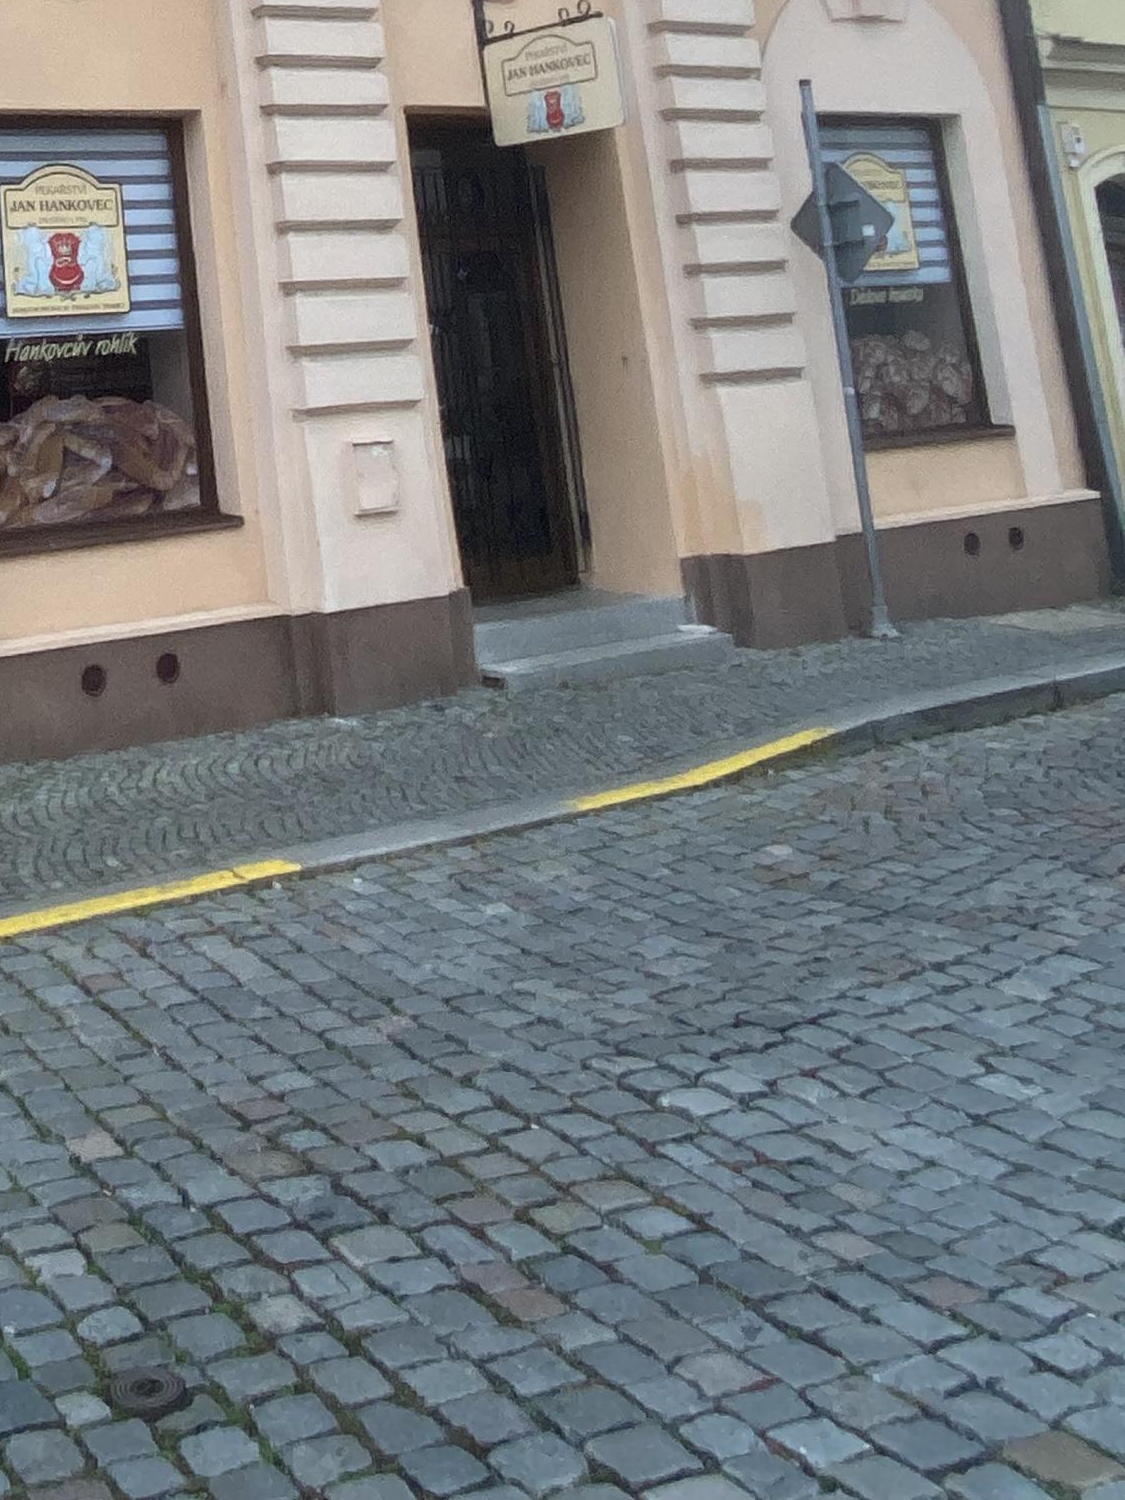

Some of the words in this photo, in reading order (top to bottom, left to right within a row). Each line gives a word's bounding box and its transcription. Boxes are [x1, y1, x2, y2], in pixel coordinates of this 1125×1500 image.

[507, 66, 527, 81] JAN
[9, 200, 35, 213] JAN
[39, 199, 113, 212] HANKOVEC
[4, 334, 93, 363] Hankovcův
